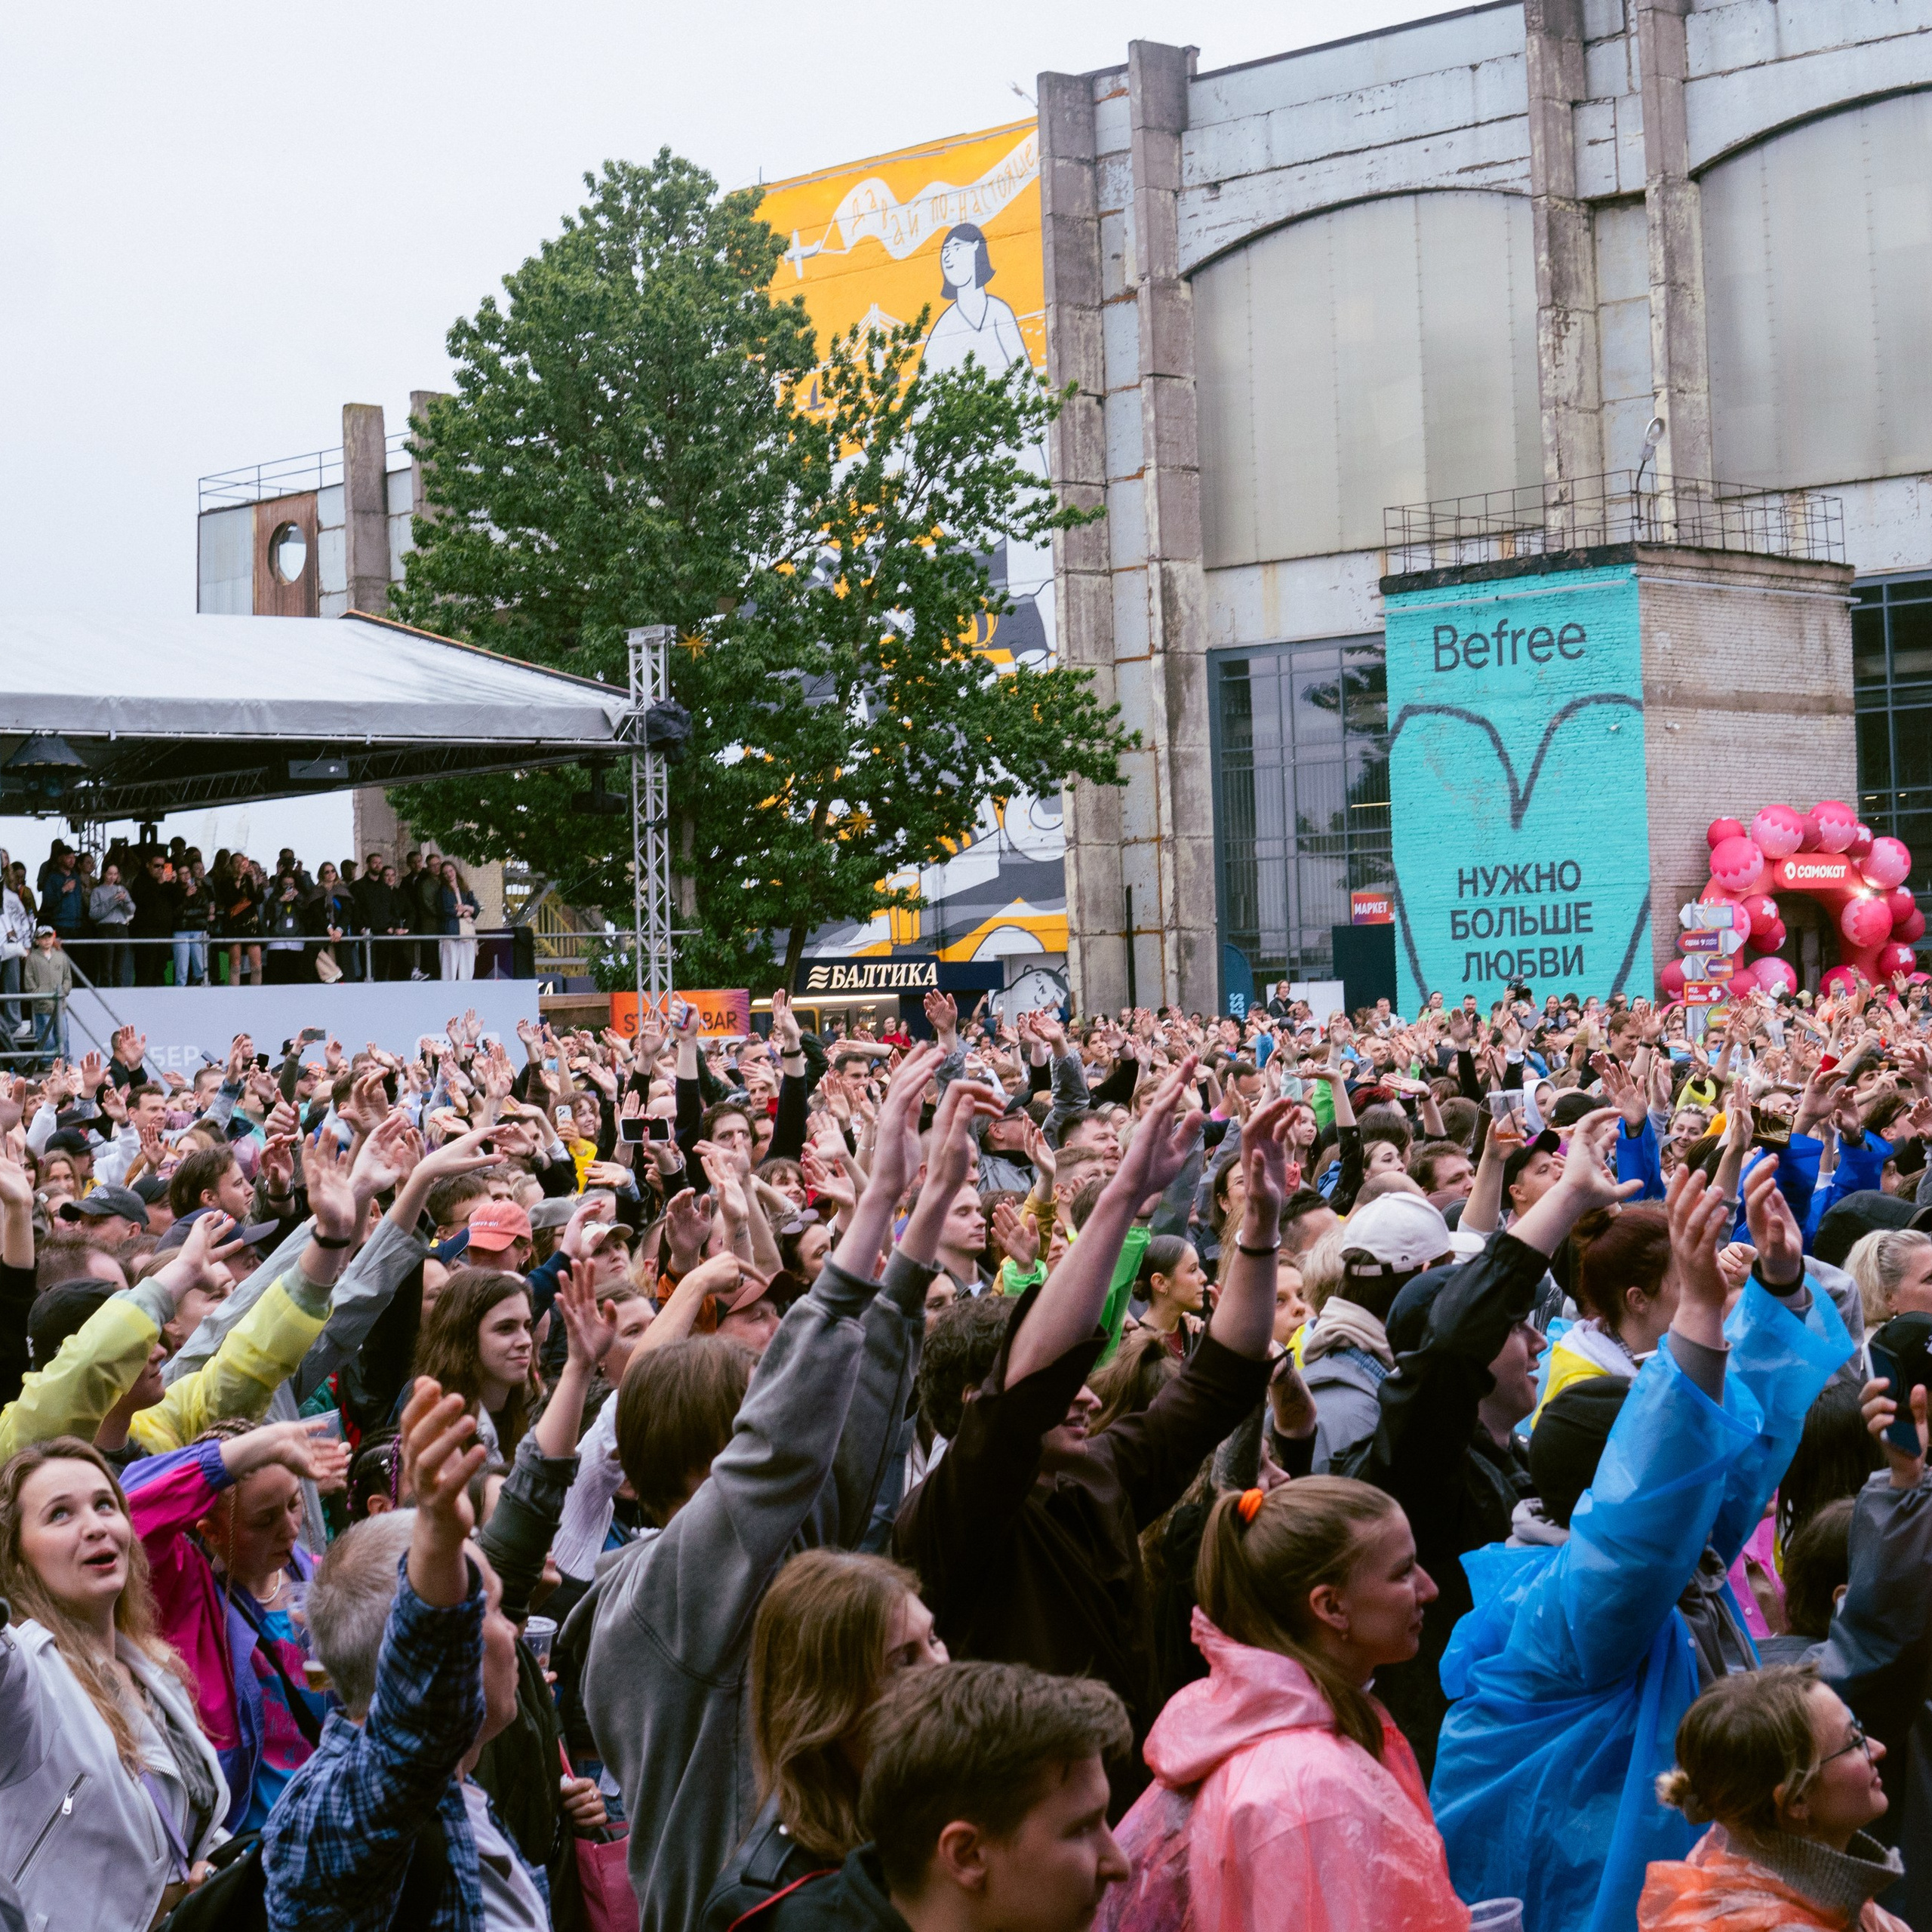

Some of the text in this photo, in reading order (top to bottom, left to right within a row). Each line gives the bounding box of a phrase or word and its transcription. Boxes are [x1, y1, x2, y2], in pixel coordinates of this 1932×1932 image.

[851, 141, 1040, 245] Давай по-настояще
[1434, 618, 1586, 672] Befree
[1457, 860, 1581, 898] НУЖНО
[1355, 901, 1388, 915] МАРКЕТ
[1450, 901, 1593, 940] БОЛЬШЕ
[829, 962, 939, 989] БАЛТИКА
[1461, 944, 1584, 982] ЛЮБВИ
[703, 1011, 737, 1031] BAR
